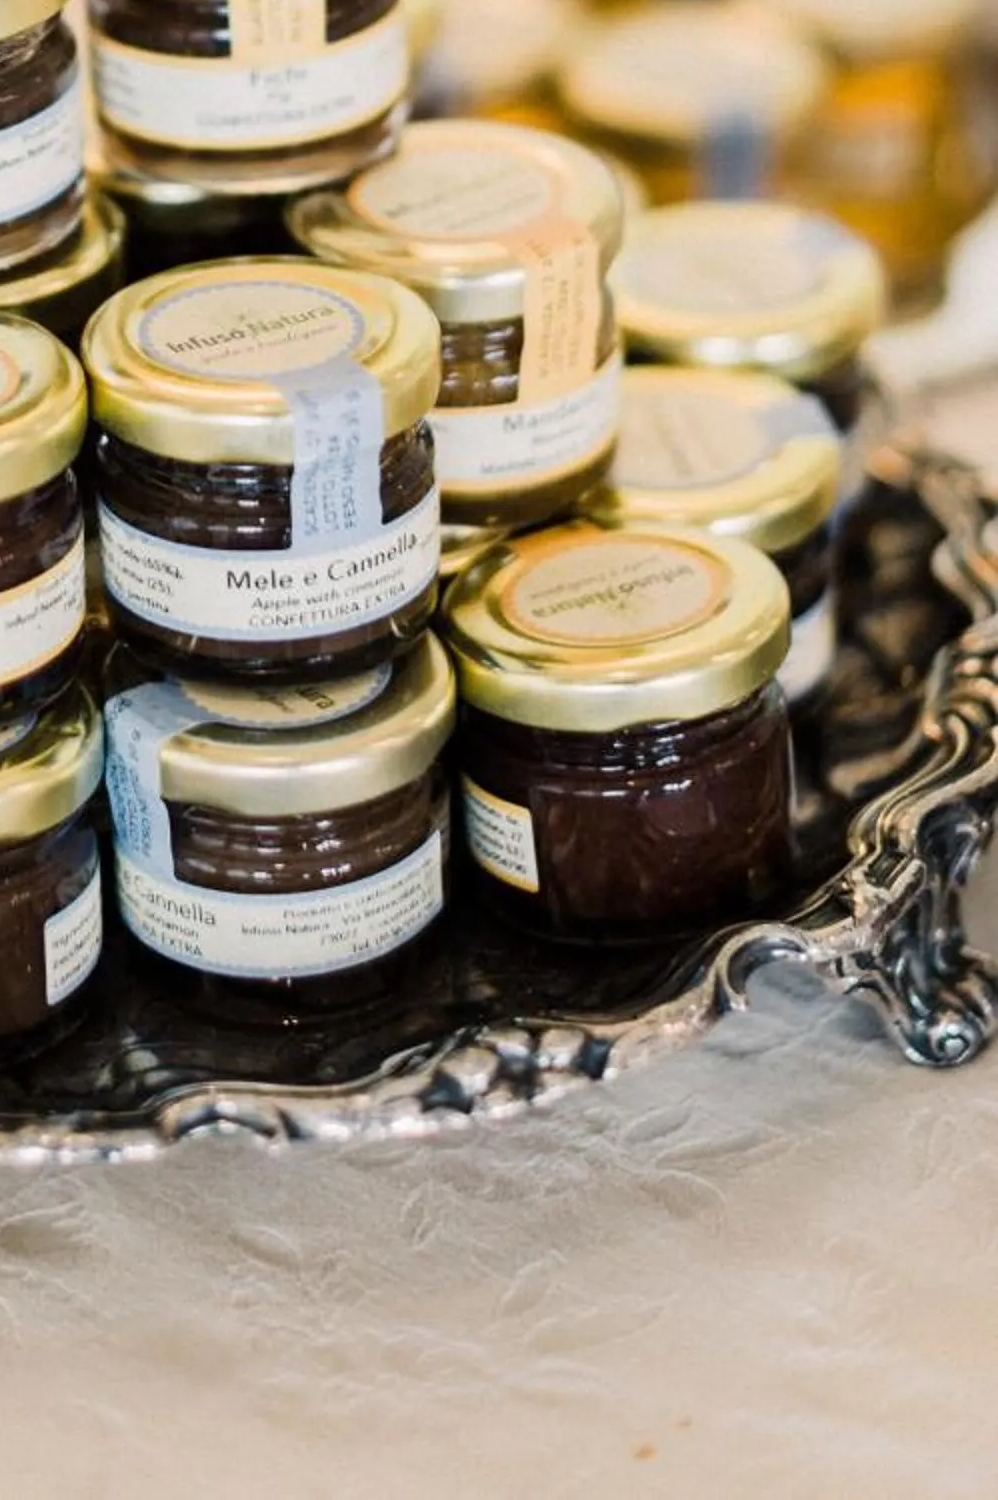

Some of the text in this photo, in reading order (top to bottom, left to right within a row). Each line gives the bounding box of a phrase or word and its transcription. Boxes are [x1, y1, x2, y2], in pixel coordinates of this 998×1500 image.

[165, 328, 247, 356] Infuso
[248, 305, 336, 337] Natura
[225, 531, 419, 592] Mele e Cannella
[247, 584, 407, 629] CONFETTURA EXTRA
[252, 596, 300, 612] Apple
[304, 587, 341, 607] with
[133, 873, 218, 926] Cannella
[160, 930, 204, 958] EXTRA
